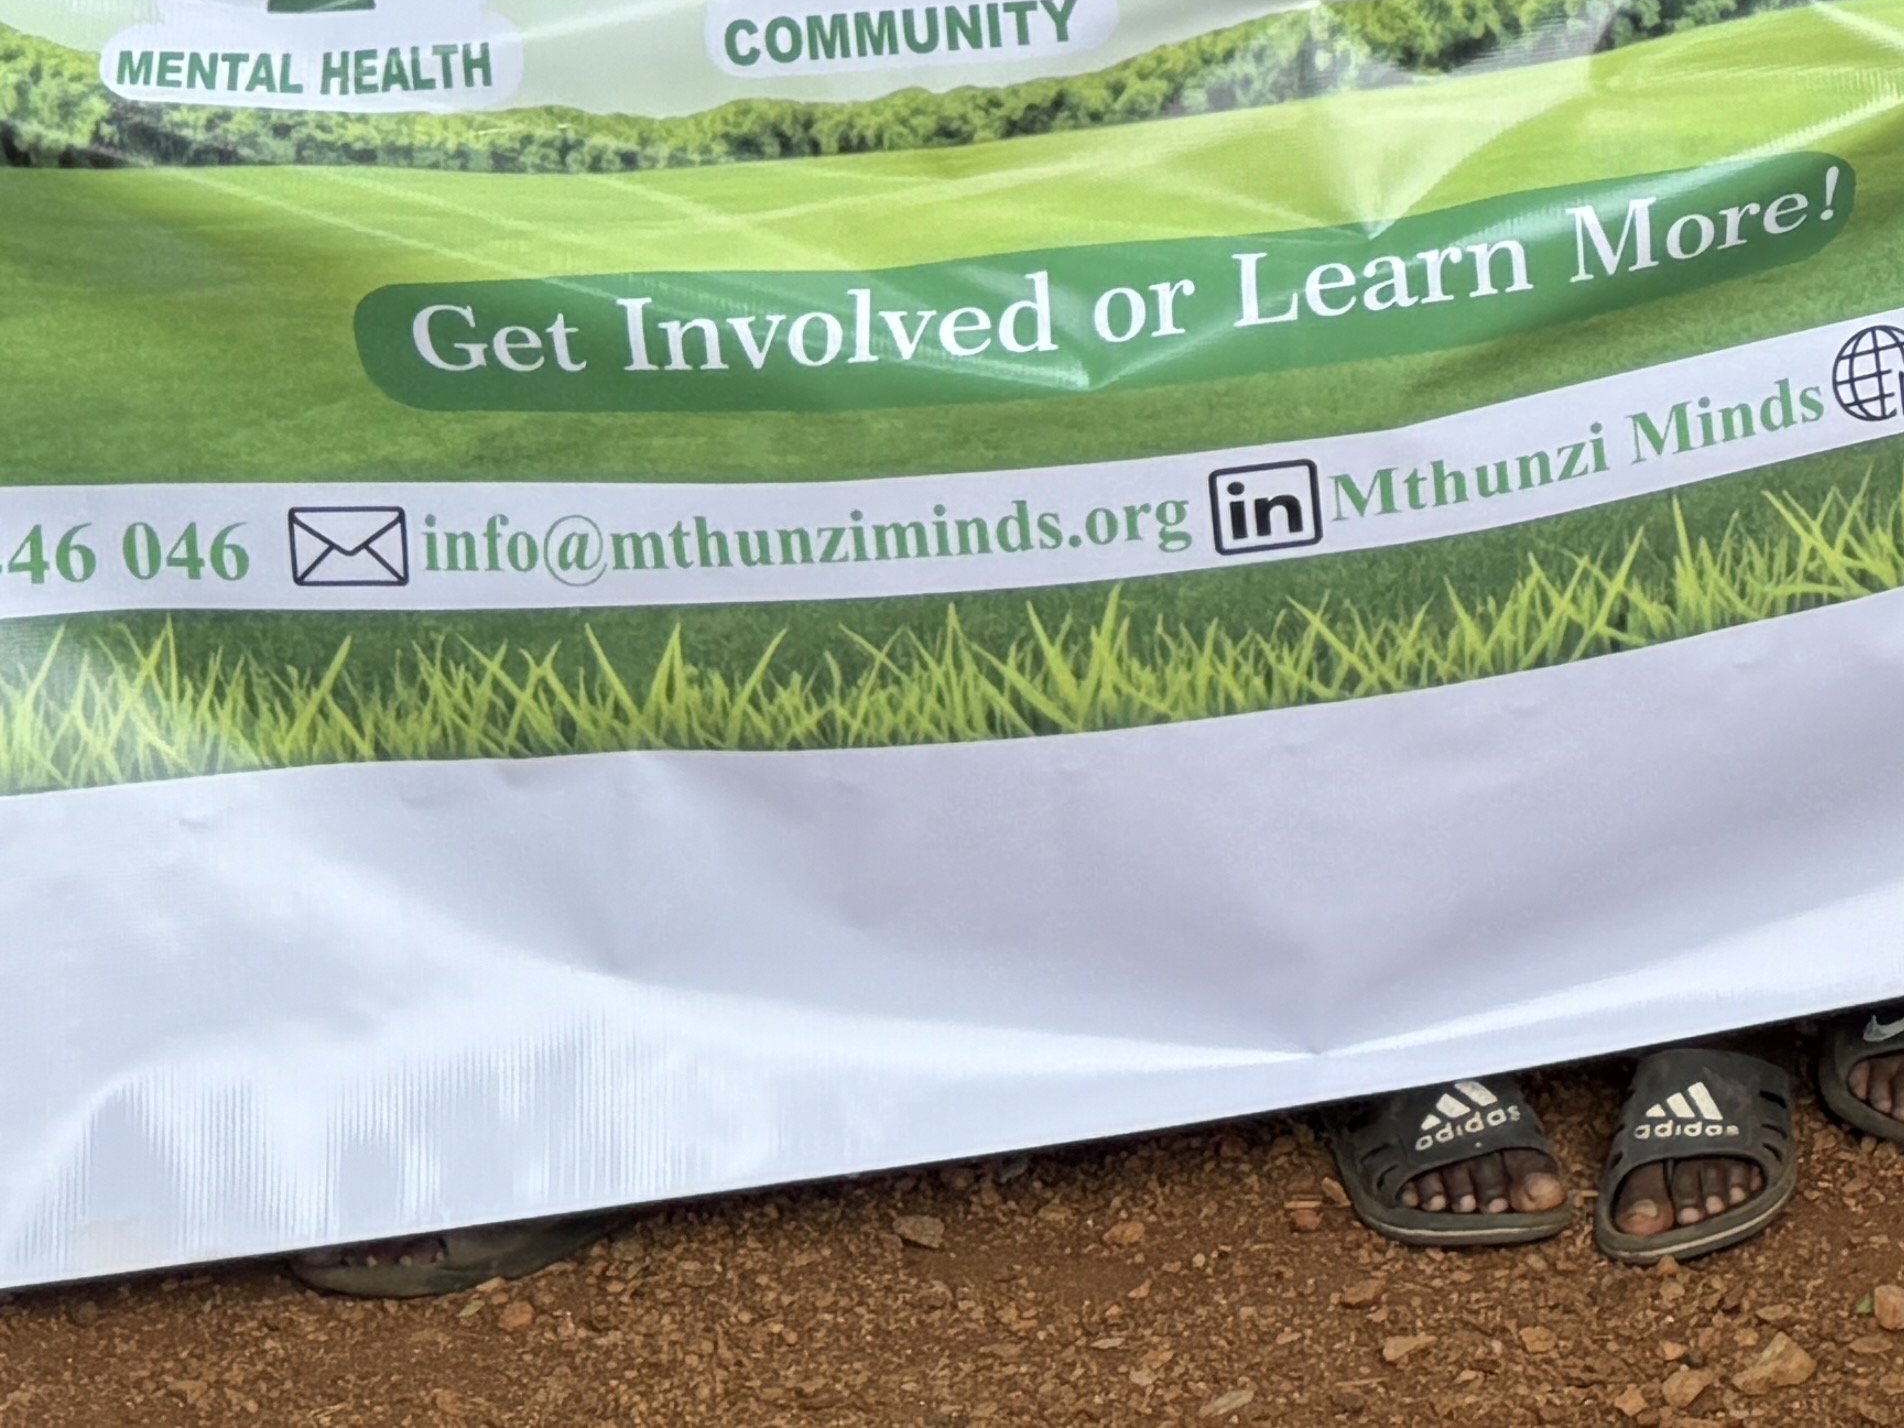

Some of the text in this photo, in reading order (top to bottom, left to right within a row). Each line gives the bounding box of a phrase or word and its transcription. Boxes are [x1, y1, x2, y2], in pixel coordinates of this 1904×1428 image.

[116, 42, 493, 95] MENTAL HEALTH
[412, 165, 1840, 373] Get Involved or Learn More!
[0, 521, 97, 585] 46
[122, 521, 250, 581] 046
[422, 498, 1193, 587] info@mthunziminds.org
[1331, 421, 1610, 522] Mthunzi
[1626, 377, 1825, 465] Minds
[1415, 1105, 1521, 1151] adidas
[1634, 1119, 1740, 1140] adidas
